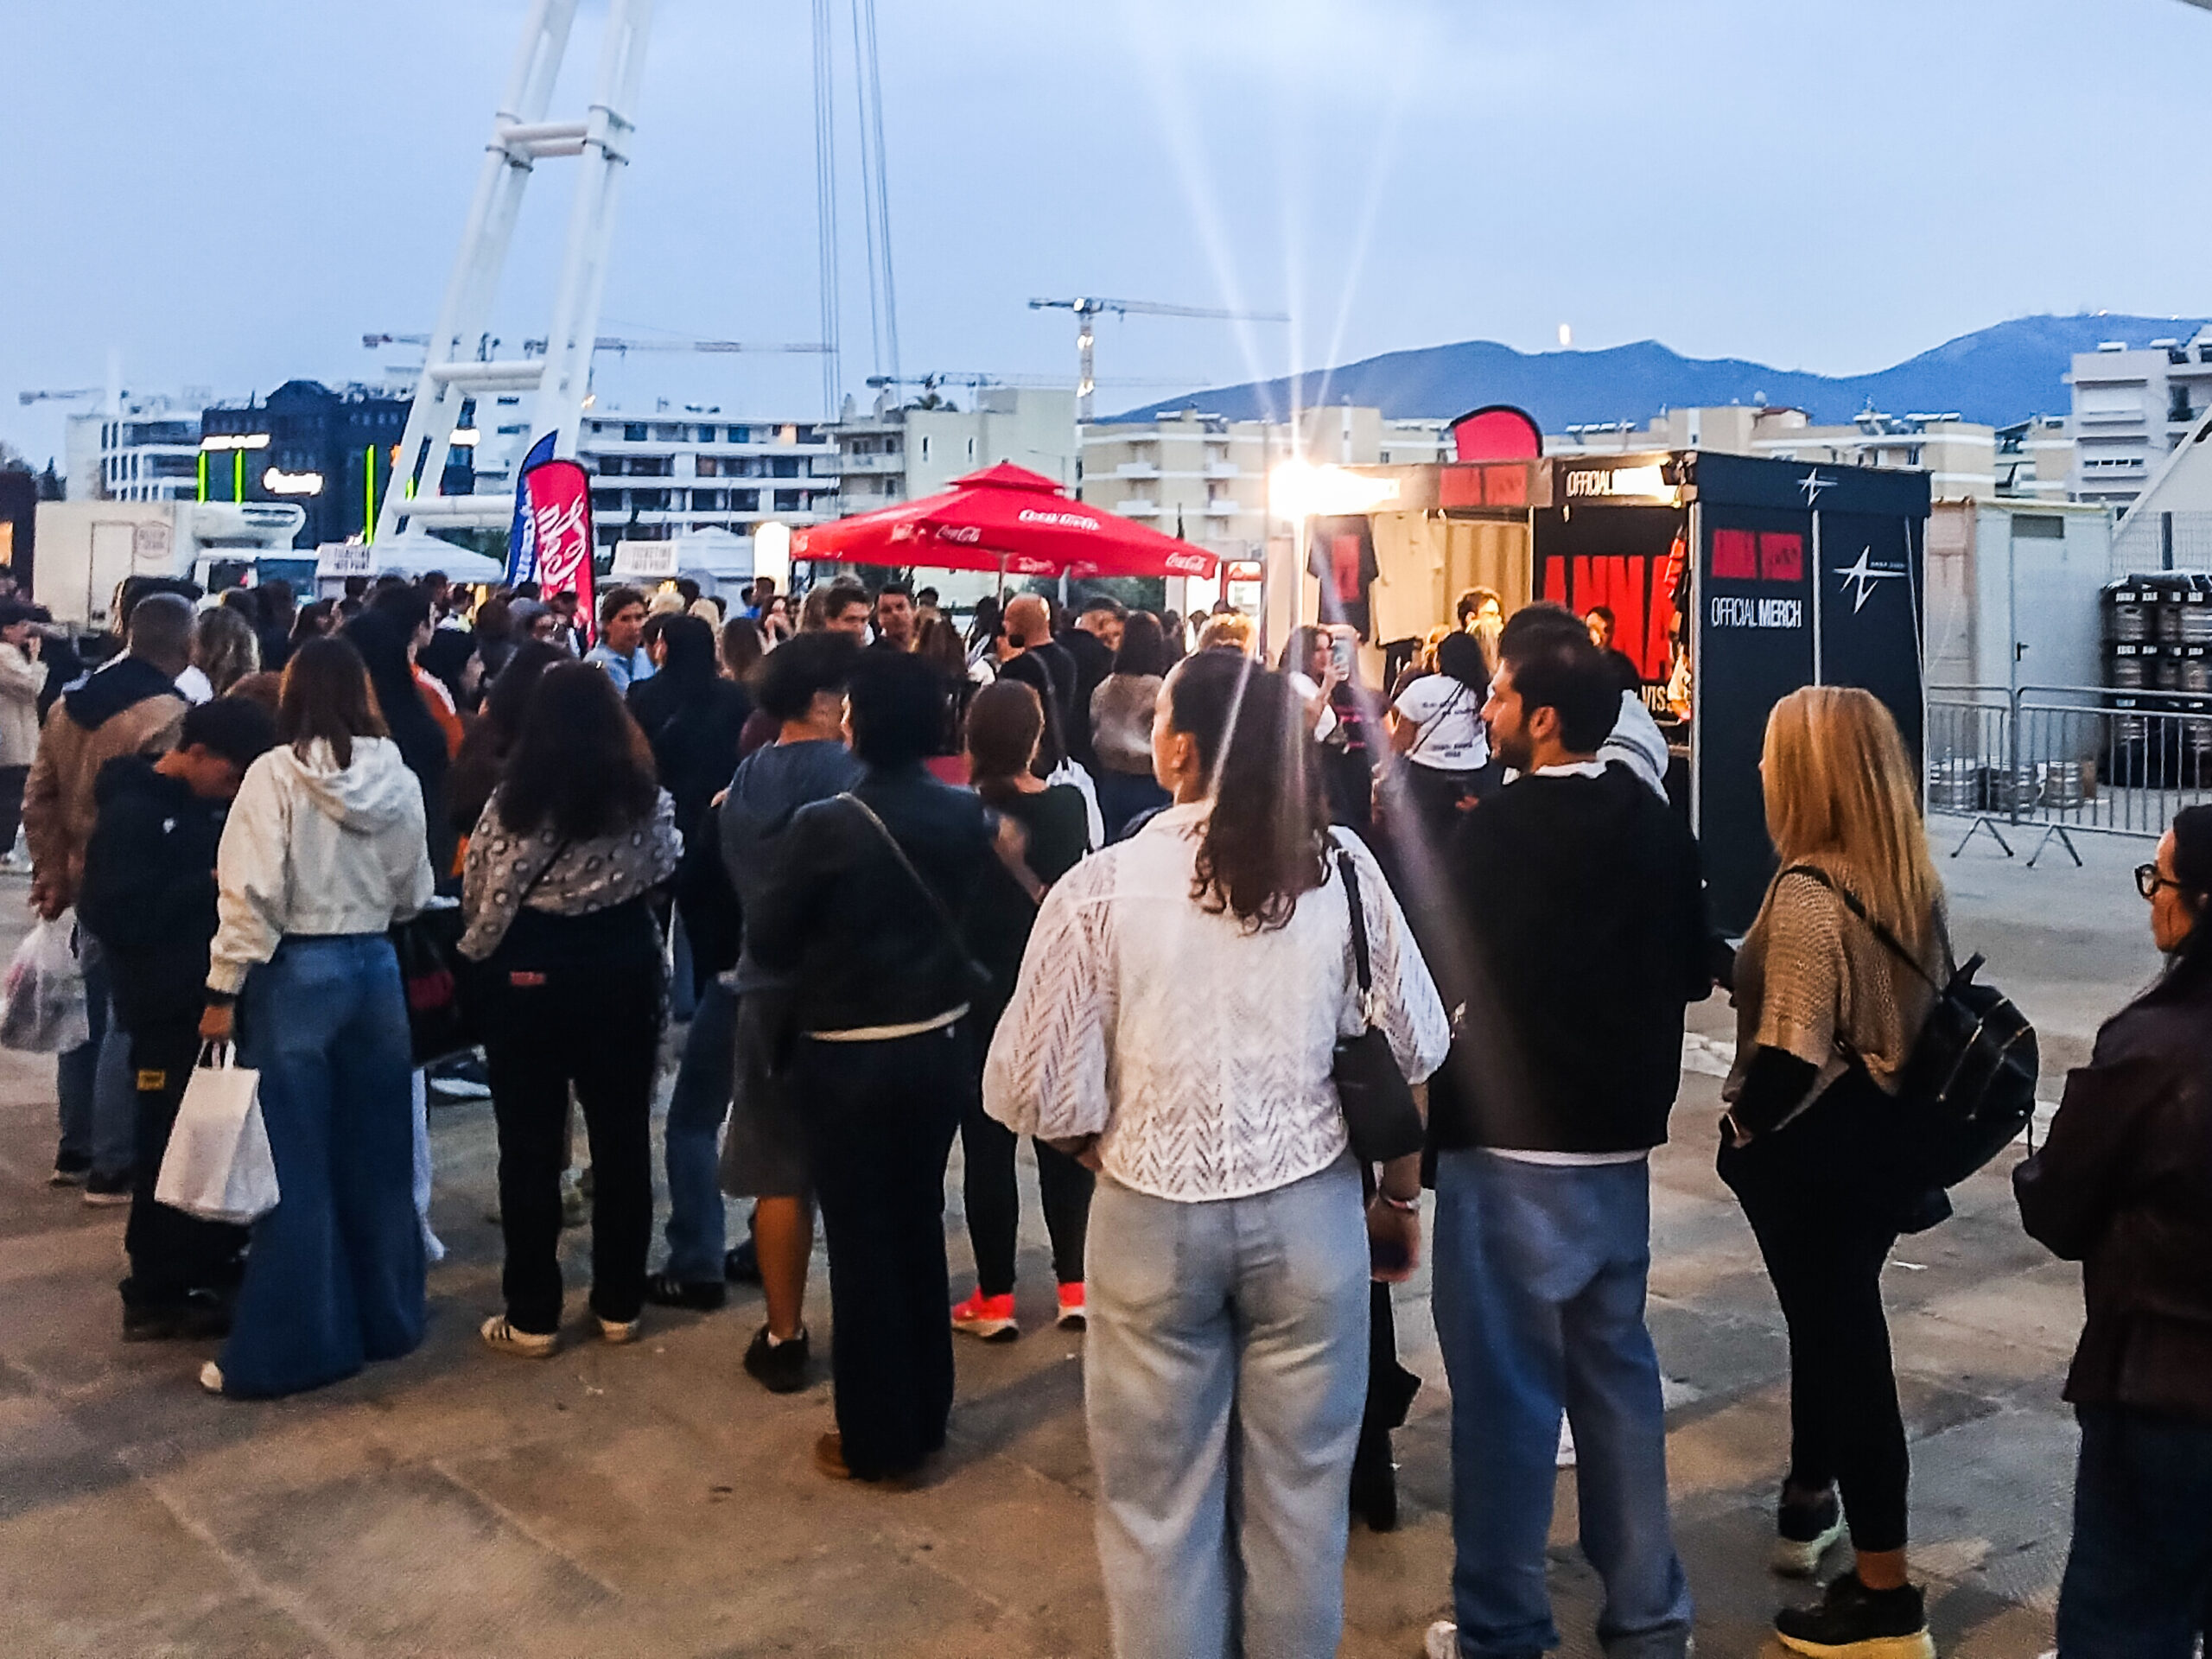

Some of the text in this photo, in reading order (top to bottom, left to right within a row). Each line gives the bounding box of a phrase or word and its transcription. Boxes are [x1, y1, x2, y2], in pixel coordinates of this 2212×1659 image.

[1566, 470, 1612, 497] OFFICIAL
[1712, 597, 1802, 628] OFFICIAL MERCH
